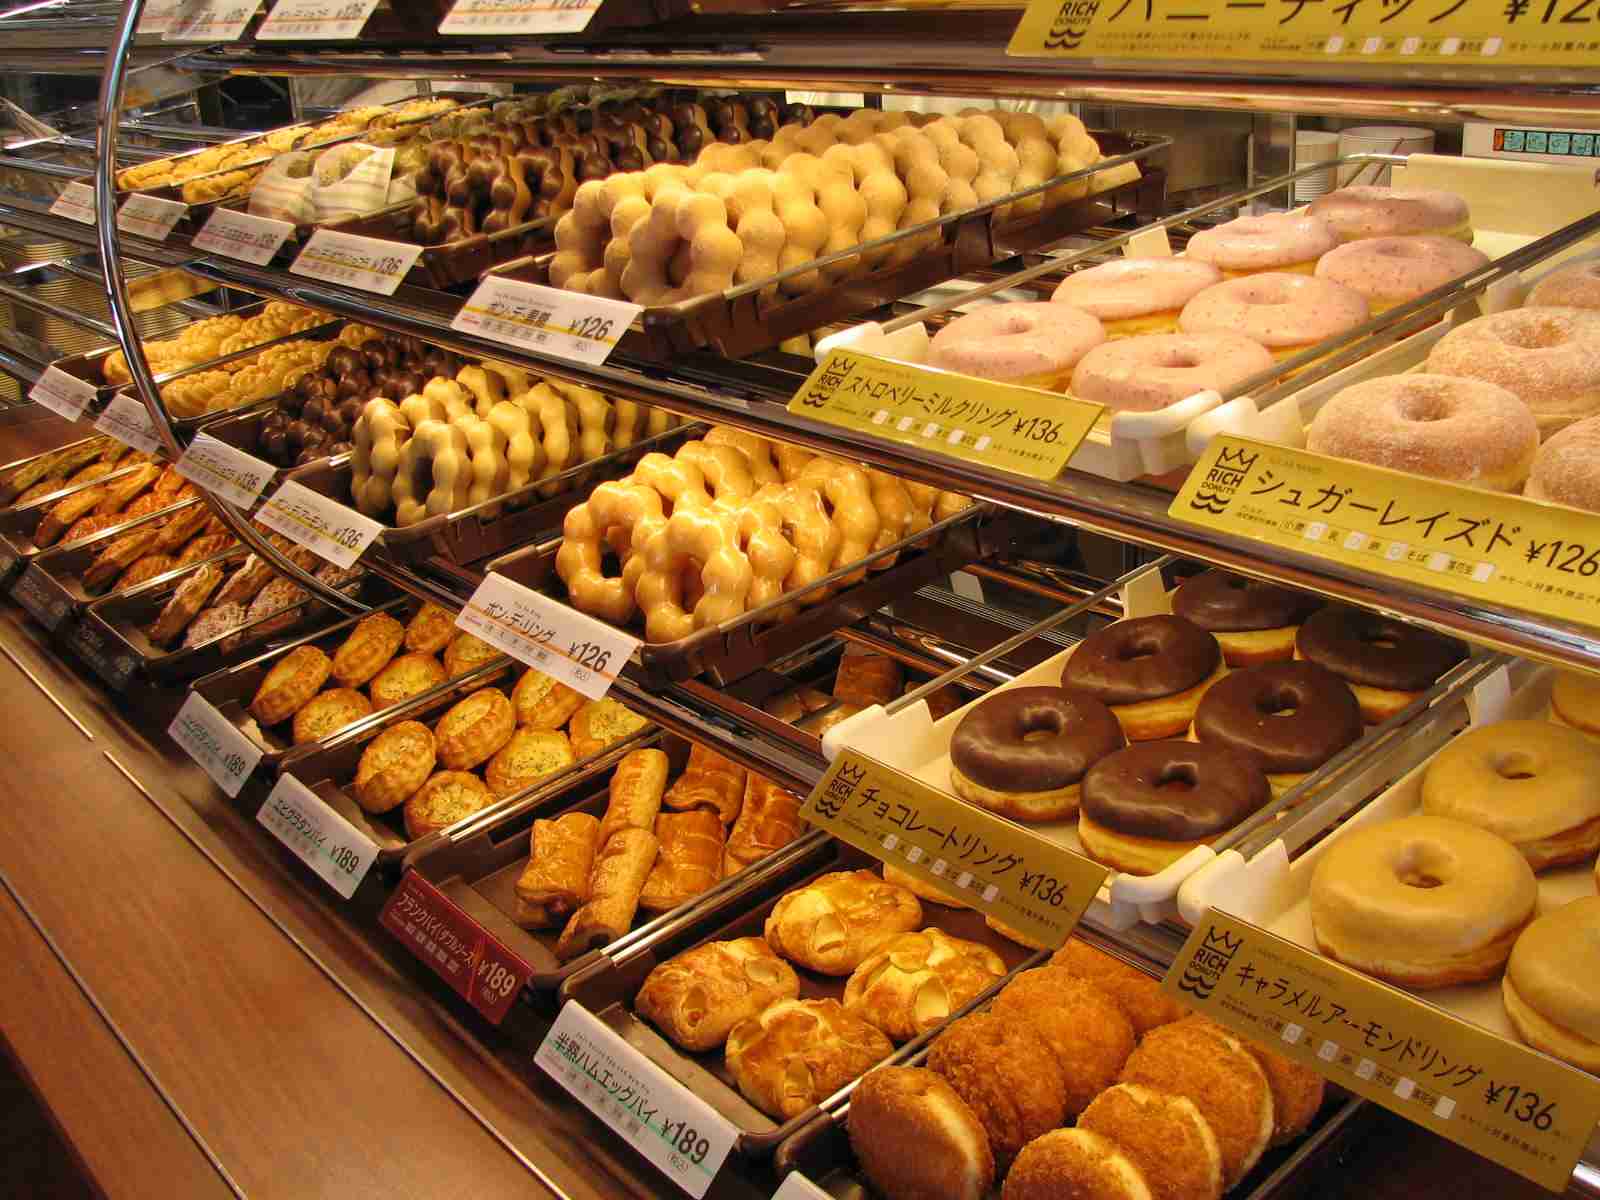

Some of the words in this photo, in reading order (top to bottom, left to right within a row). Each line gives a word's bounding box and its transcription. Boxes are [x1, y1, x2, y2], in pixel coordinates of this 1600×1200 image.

[1059, 1, 1100, 17] RICH
[1503, 0, 1600, 24] ¥12
[569, 315, 614, 340] ¥126
[818, 374, 843, 388] RICH
[846, 376, 1018, 428] ストロベリーミルクリング
[1012, 417, 1065, 444] ¥136
[1206, 469, 1244, 488] RICH
[1250, 470, 1522, 553] シュガーレイズド
[1525, 540, 1600, 576] ¥126
[335, 527, 364, 549] ¥136
[569, 641, 612, 672] ¥126
[831, 779, 854, 797] RICH
[330, 845, 360, 875] ¥189
[857, 788, 1024, 875] チョコレートリング
[1019, 871, 1068, 906] ¥136
[1193, 950, 1231, 973] RICH
[478, 959, 516, 998] ¥189
[1236, 961, 1484, 1087] キャラメルアーモンドリング
[1485, 1080, 1557, 1131] ¥136
[553, 1030, 659, 1125] 半熟ハムエッグパイ
[659, 1116, 711, 1166] ¥189
